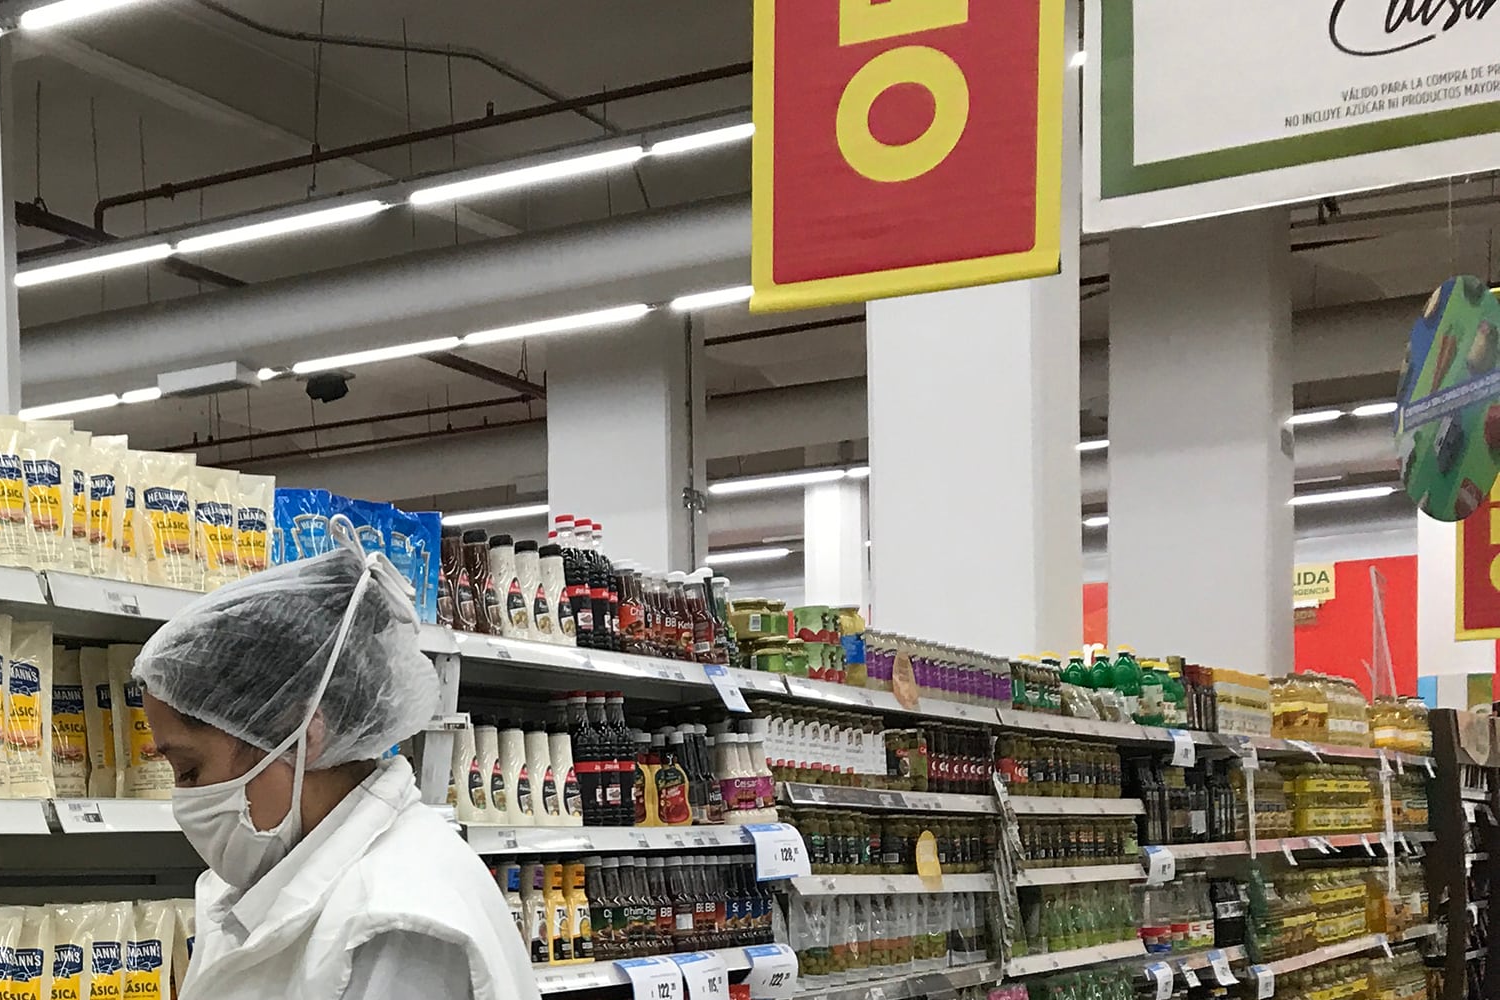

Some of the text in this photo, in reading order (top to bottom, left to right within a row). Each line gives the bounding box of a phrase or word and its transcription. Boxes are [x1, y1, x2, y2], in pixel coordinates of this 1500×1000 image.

[1342, 85, 1378, 102] VÁLIDO
[1381, 81, 1407, 96] PARA
[1411, 78, 1422, 90] LA
[1427, 72, 1467, 87] COMPRA
[1472, 67, 1483, 78] DE
[1285, 116, 1299, 128] NO
[1303, 109, 1341, 125] INCLUYE
[1346, 98, 1385, 117] AZÚCAR
[1402, 86, 1461, 106] PRODUCTOS
[1294, 571, 1330, 586] IDA
